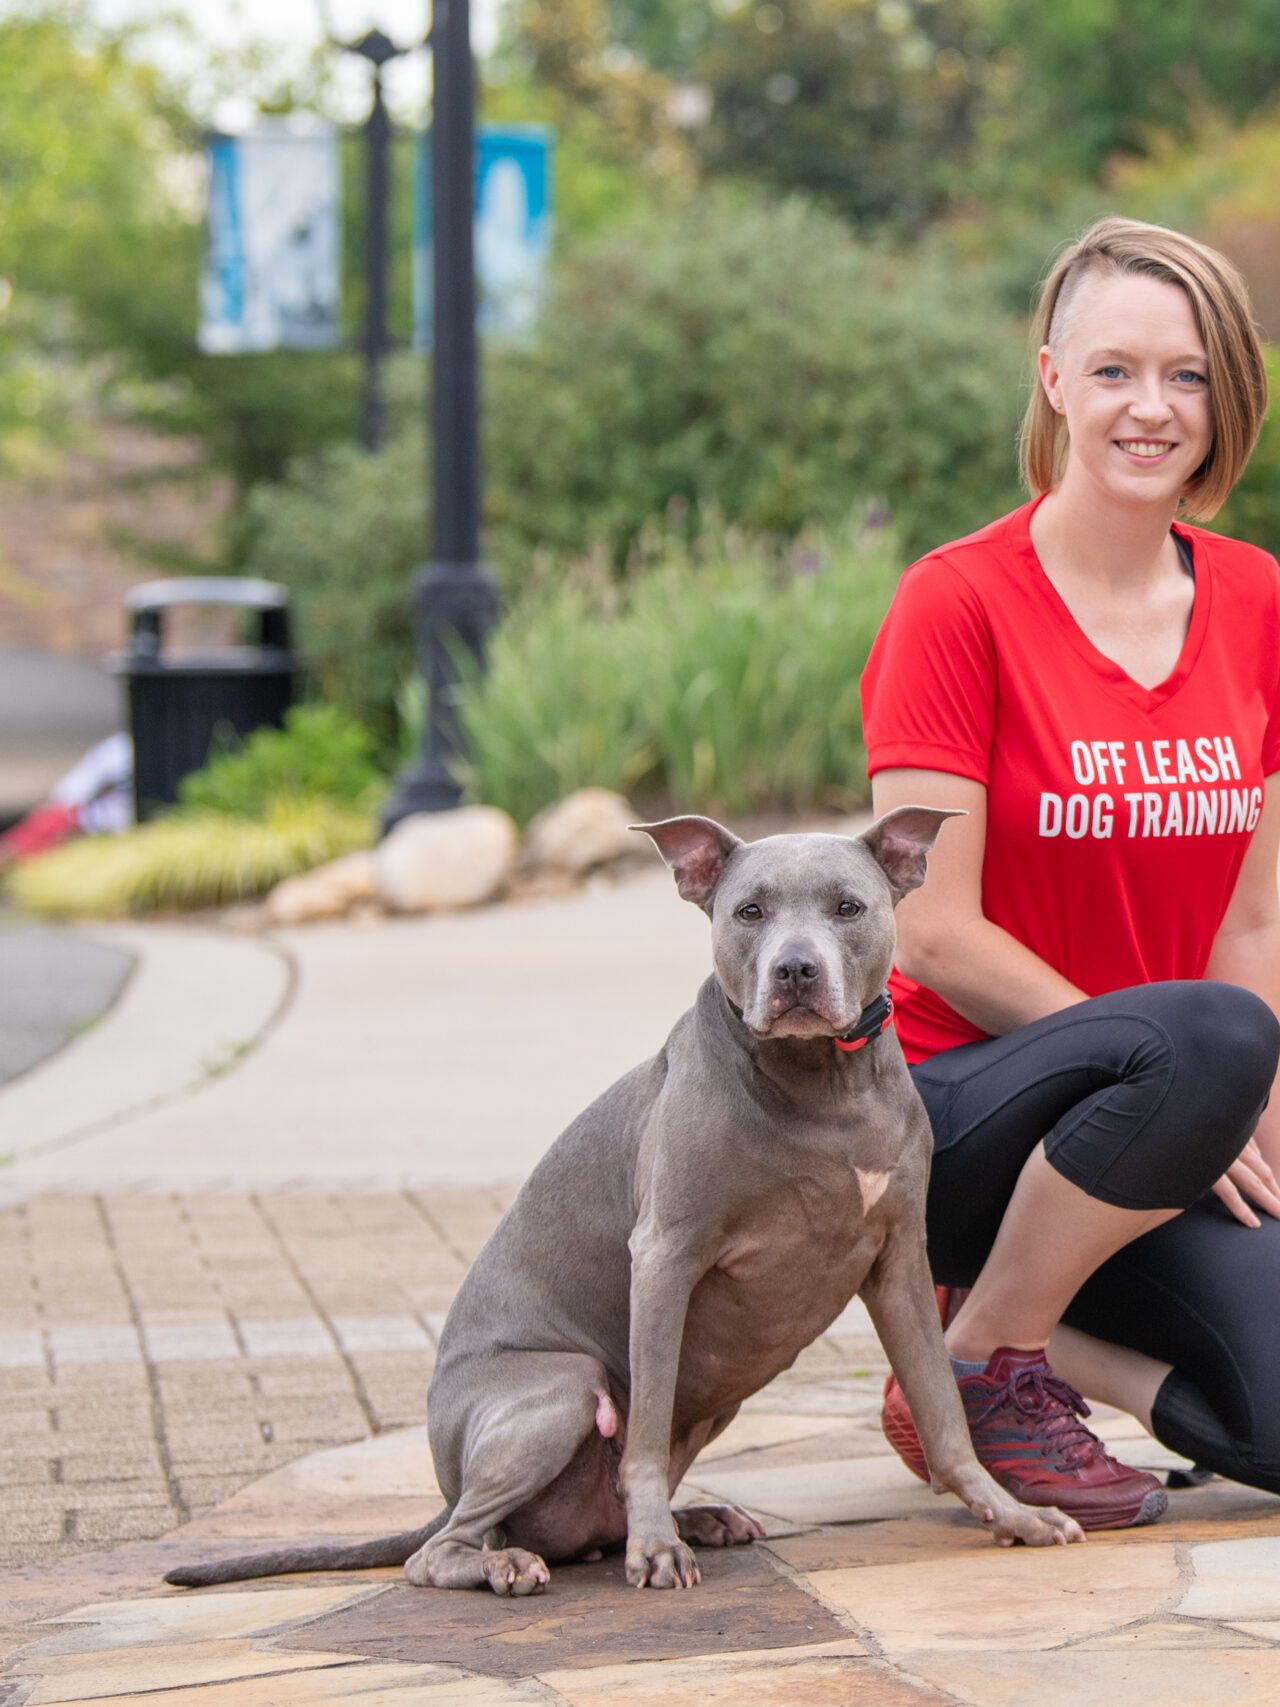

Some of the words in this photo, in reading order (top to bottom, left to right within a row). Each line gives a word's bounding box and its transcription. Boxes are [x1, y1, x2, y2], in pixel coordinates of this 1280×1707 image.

[1071, 740, 1126, 786] OFF
[1134, 736, 1241, 785] LEASH
[1039, 792, 1114, 839] DOG
[1124, 787, 1262, 838] TRAINING
